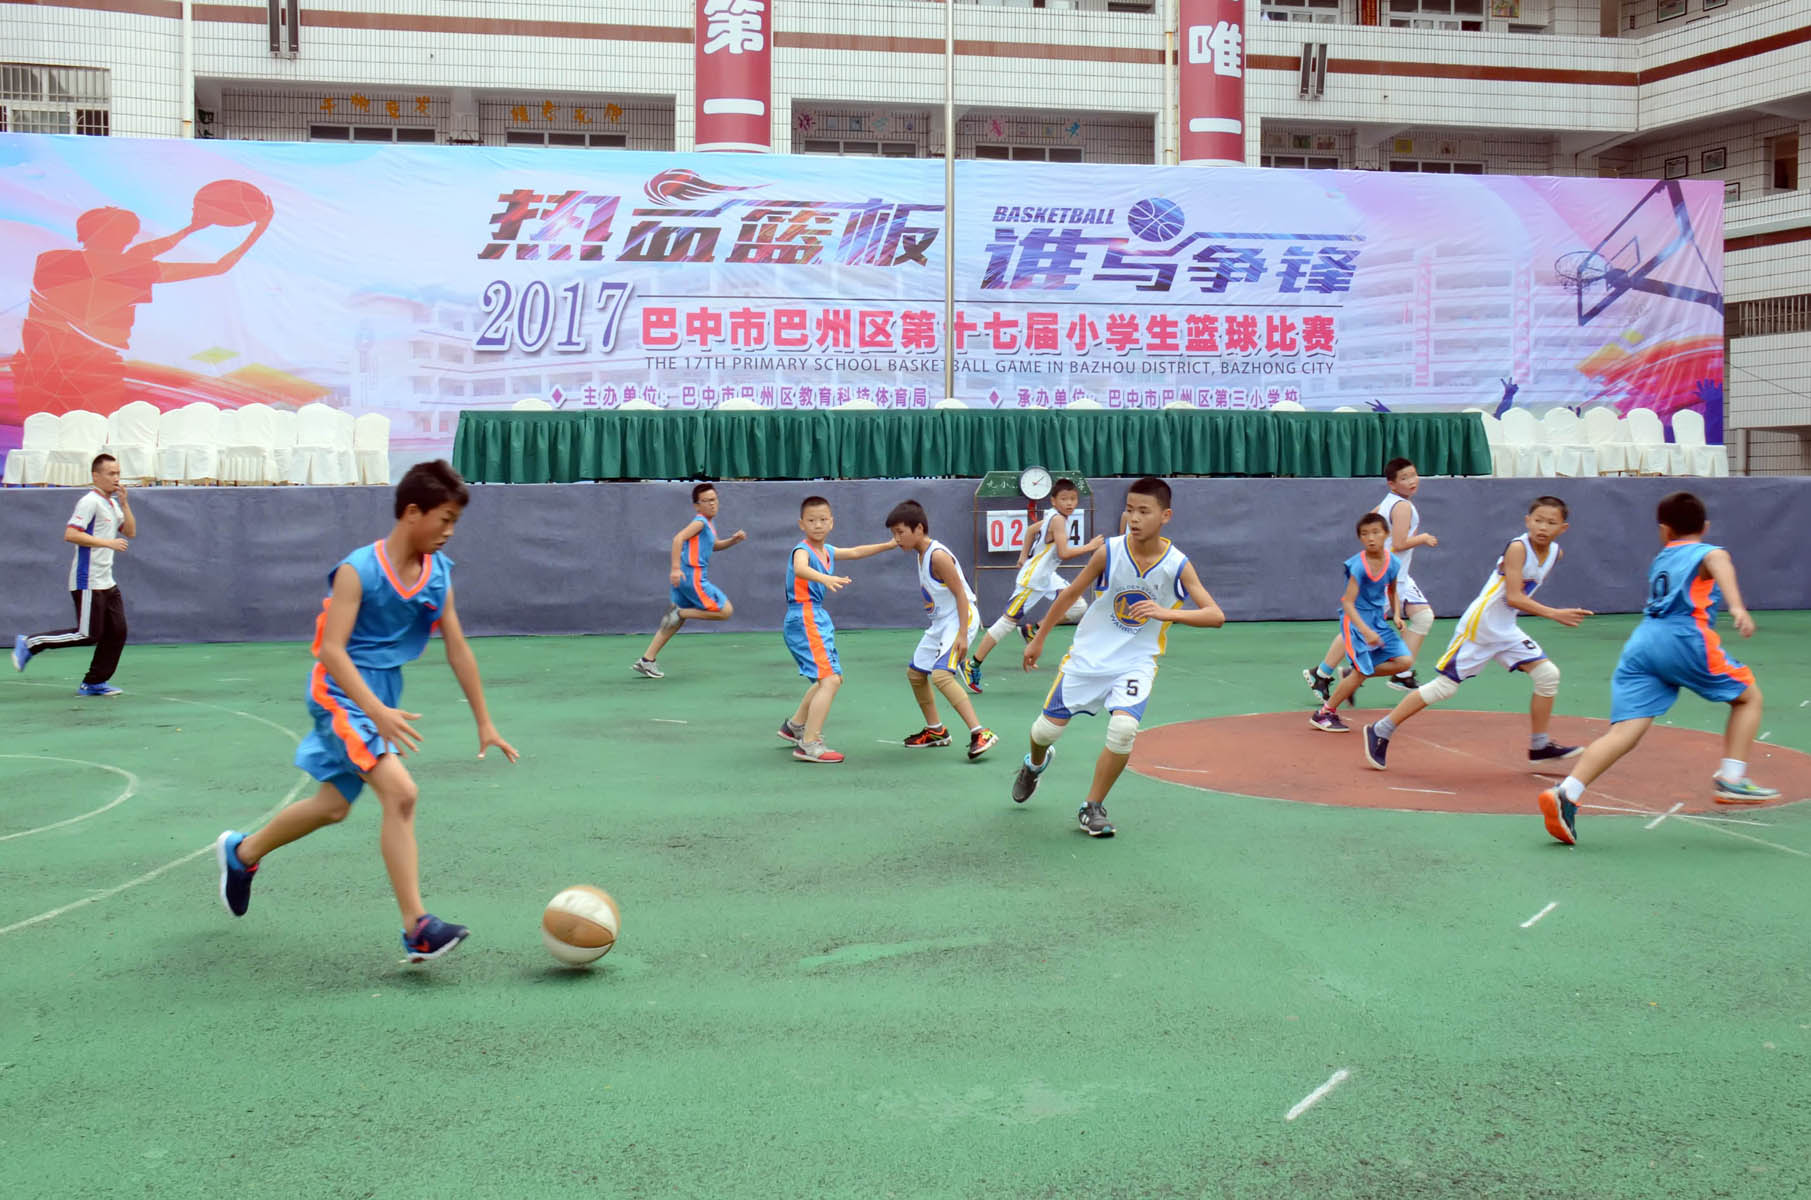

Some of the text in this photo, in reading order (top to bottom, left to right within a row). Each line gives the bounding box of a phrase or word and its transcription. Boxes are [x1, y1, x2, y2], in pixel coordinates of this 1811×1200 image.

[477, 187, 945, 267] 热血篮板
[992, 206, 1115, 225] BASKETBALL
[980, 227, 1362, 294] 谁与争锋
[475, 279, 1335, 352] 2017 巴中市巴州区第十七届小学生篮球比赛
[646, 356, 677, 370] THE
[685, 356, 726, 370] 17TH
[733, 357, 808, 371] PRIMARY
[814, 358, 882, 372] SCHOOL
[996, 360, 1041, 374] GAME
[1048, 361, 1063, 373] IN
[1070, 361, 1135, 374] BAZHOU
[1142, 361, 1215, 377] DISTRICT,
[1221, 362, 1296, 374] BAZHONG
[1301, 362, 1334, 374] CITY
[990, 519, 1024, 547] 02
[1126, 679, 1139, 697] 5
